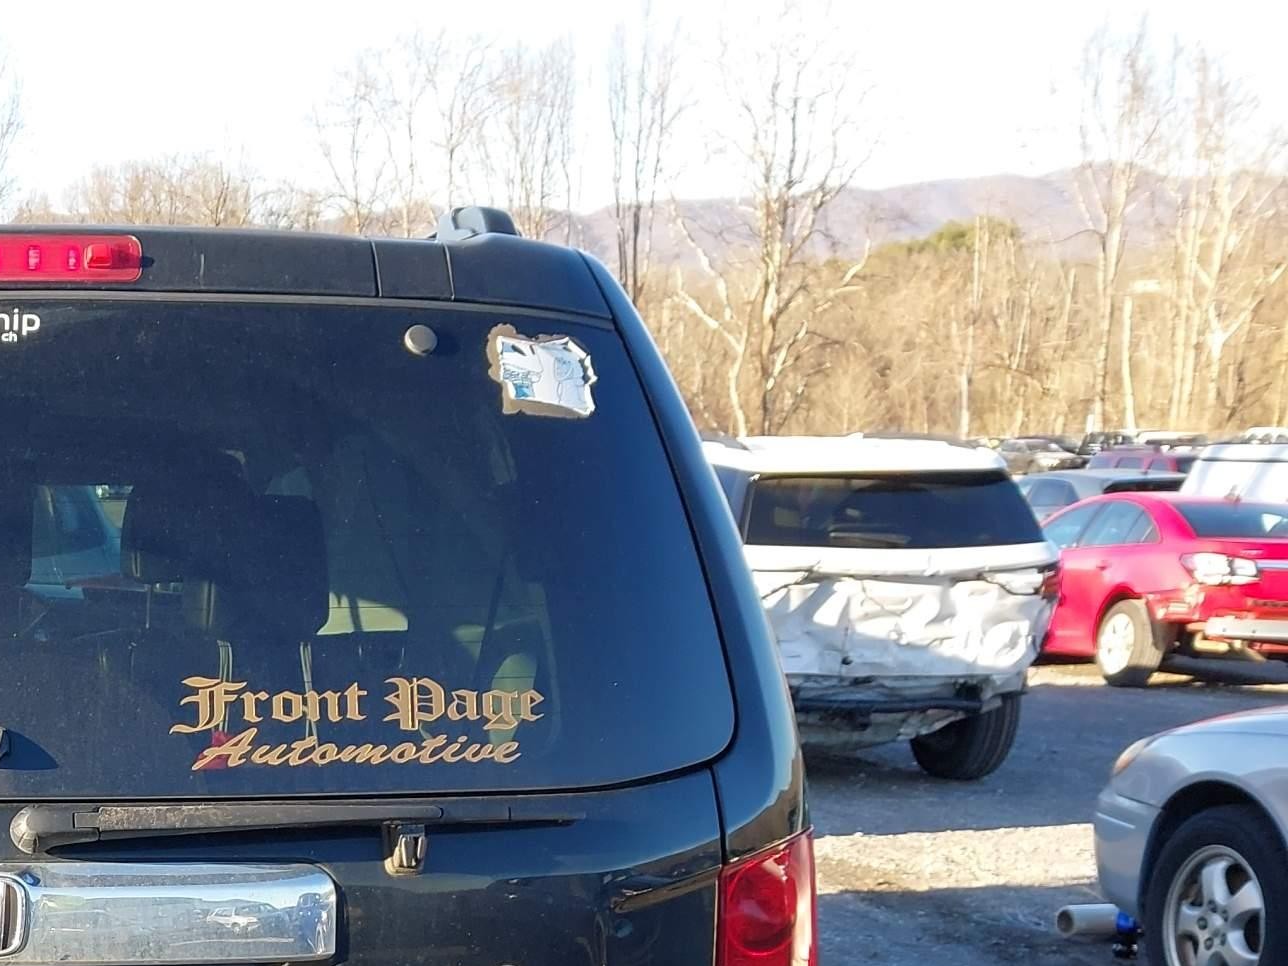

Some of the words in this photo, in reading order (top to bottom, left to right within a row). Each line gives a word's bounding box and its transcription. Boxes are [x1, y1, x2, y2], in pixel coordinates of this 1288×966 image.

[169, 676, 368, 735] Front
[383, 676, 545, 732] Page
[191, 727, 523, 772] Automotive
